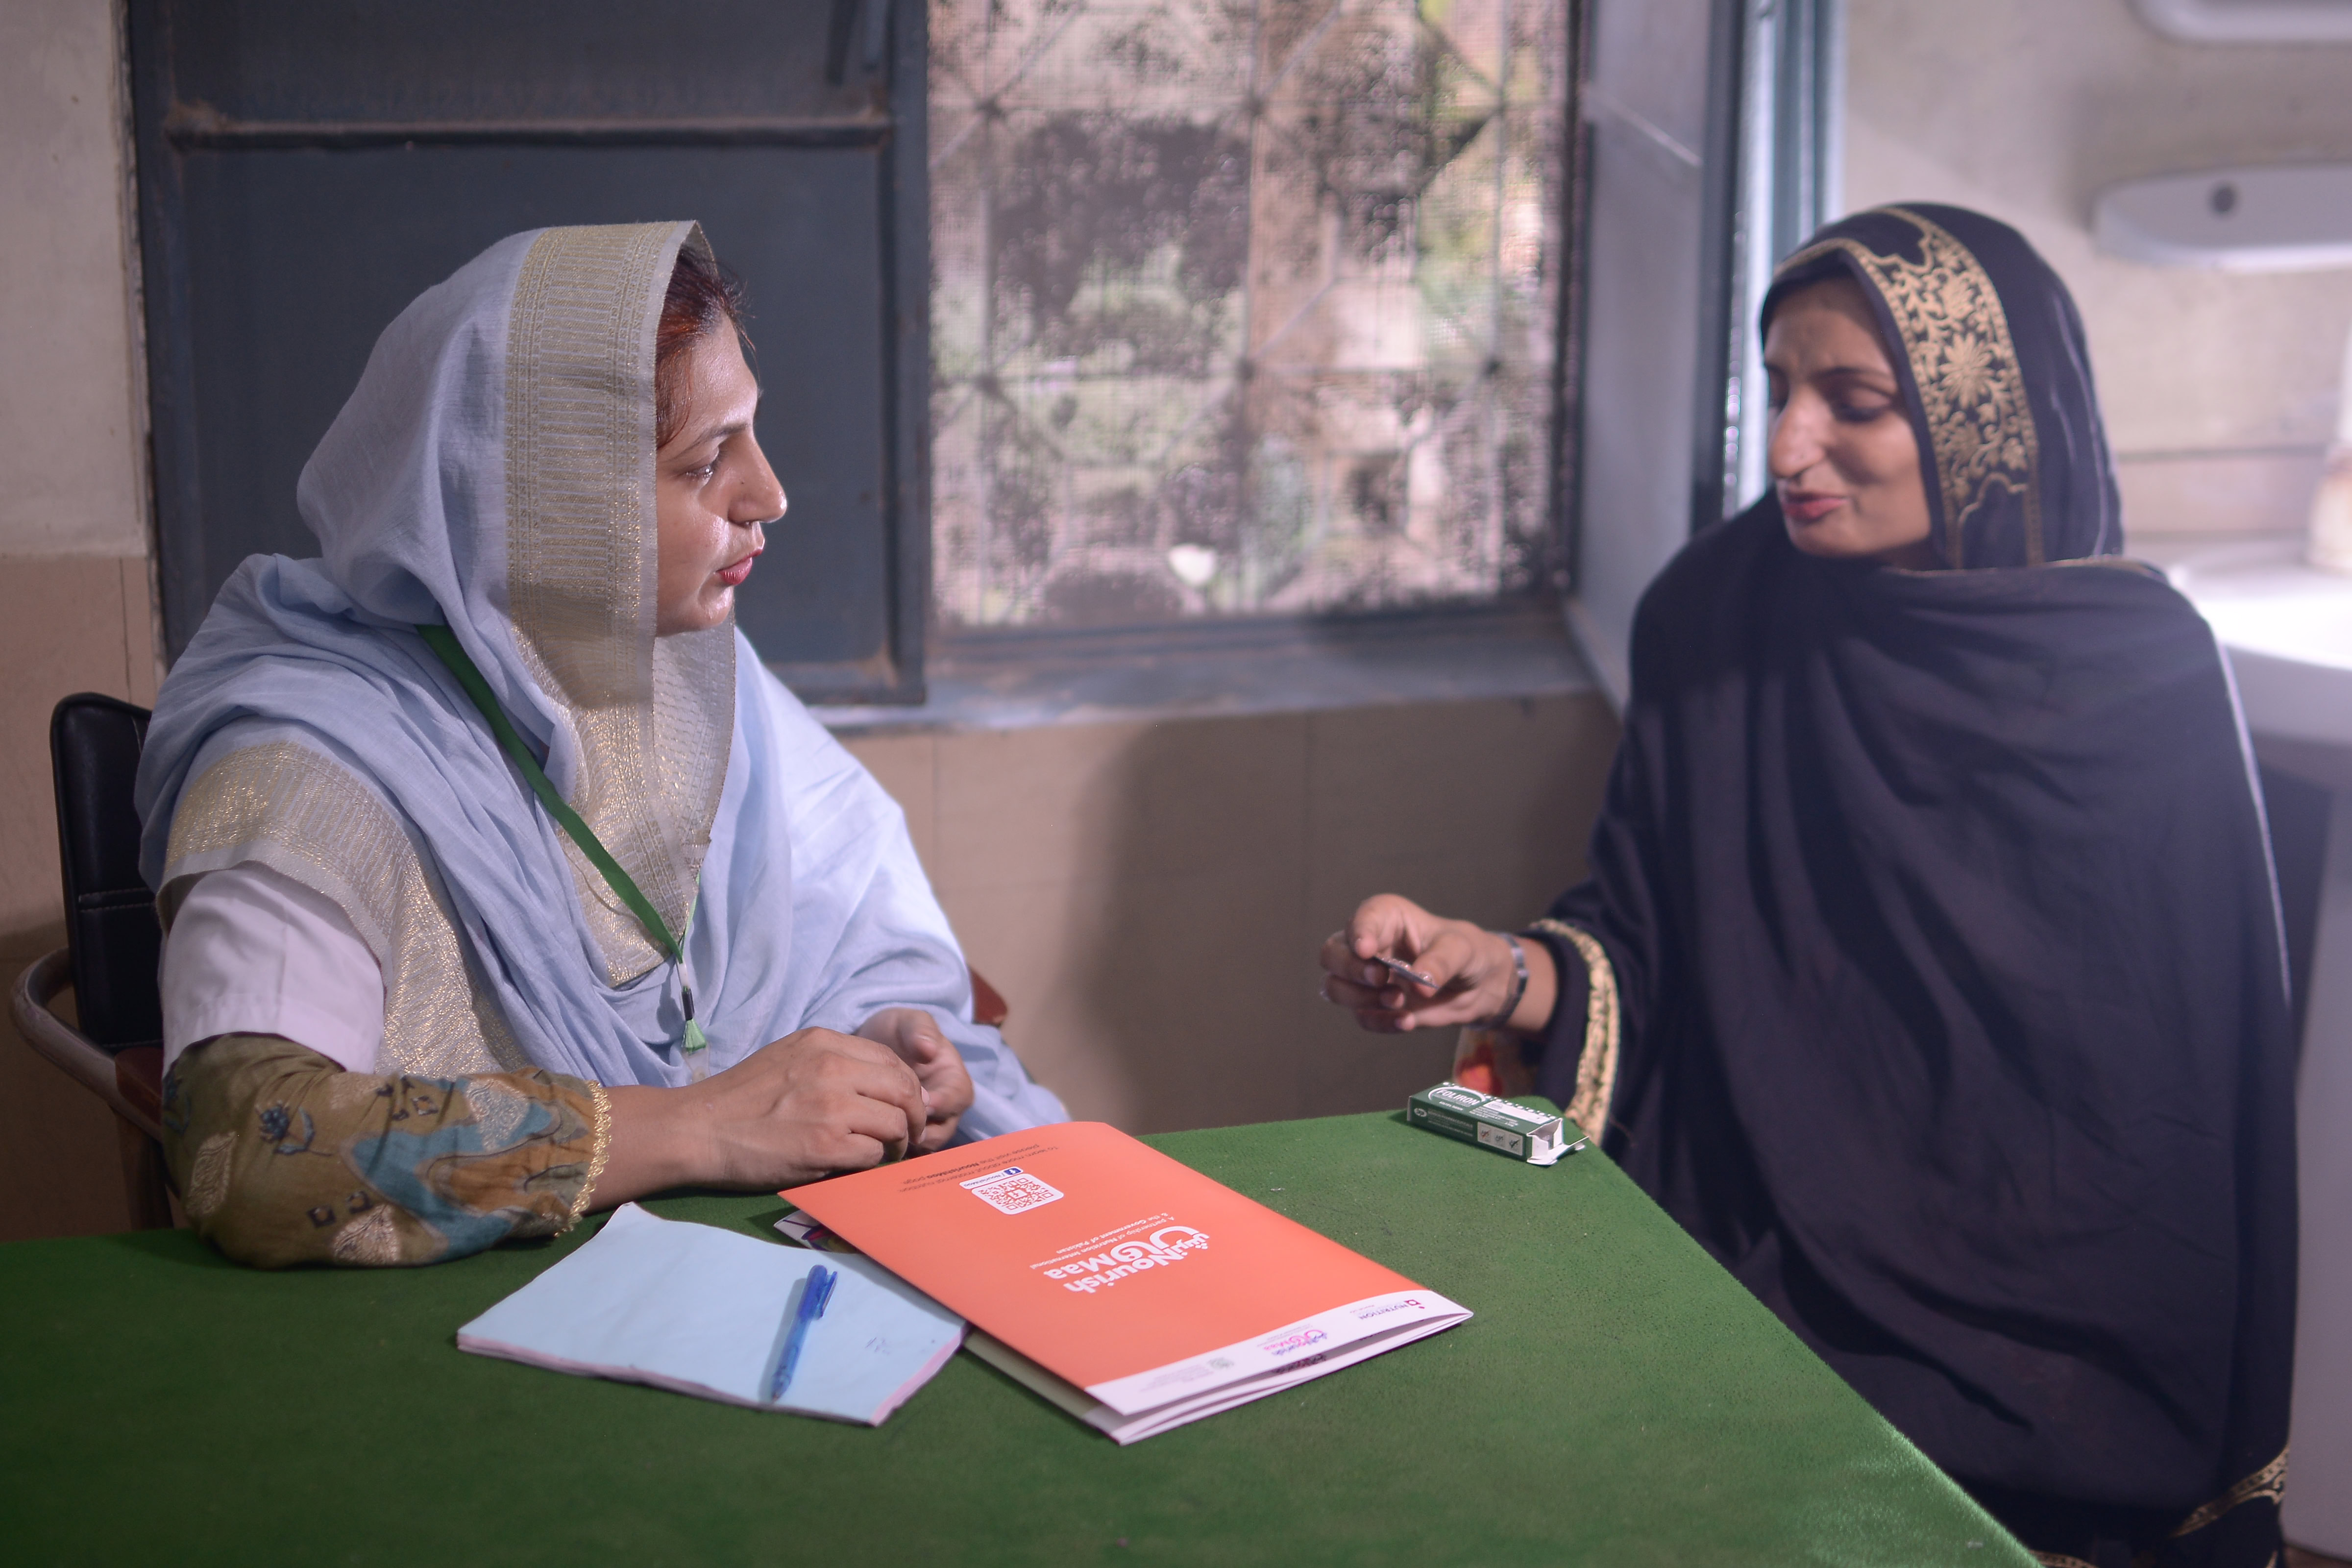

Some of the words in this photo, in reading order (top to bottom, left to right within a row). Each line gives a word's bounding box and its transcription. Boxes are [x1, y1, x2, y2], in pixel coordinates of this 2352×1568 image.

[1437, 1089, 1480, 1105] FOLIRON
[926, 1162, 980, 1179] NourishMaa
[1099, 1220, 1147, 1239] Government
[1126, 1218, 1167, 1236] partnership
[1055, 1241, 1089, 1254] Pakistan
[1080, 1238, 1118, 1253] Nutrition
[1029, 1251, 1081, 1270] International
[1043, 1253, 1117, 1279] Maa
[1063, 1248, 1184, 1293] Nourish
[1357, 1301, 1407, 1320] NUTRITION
